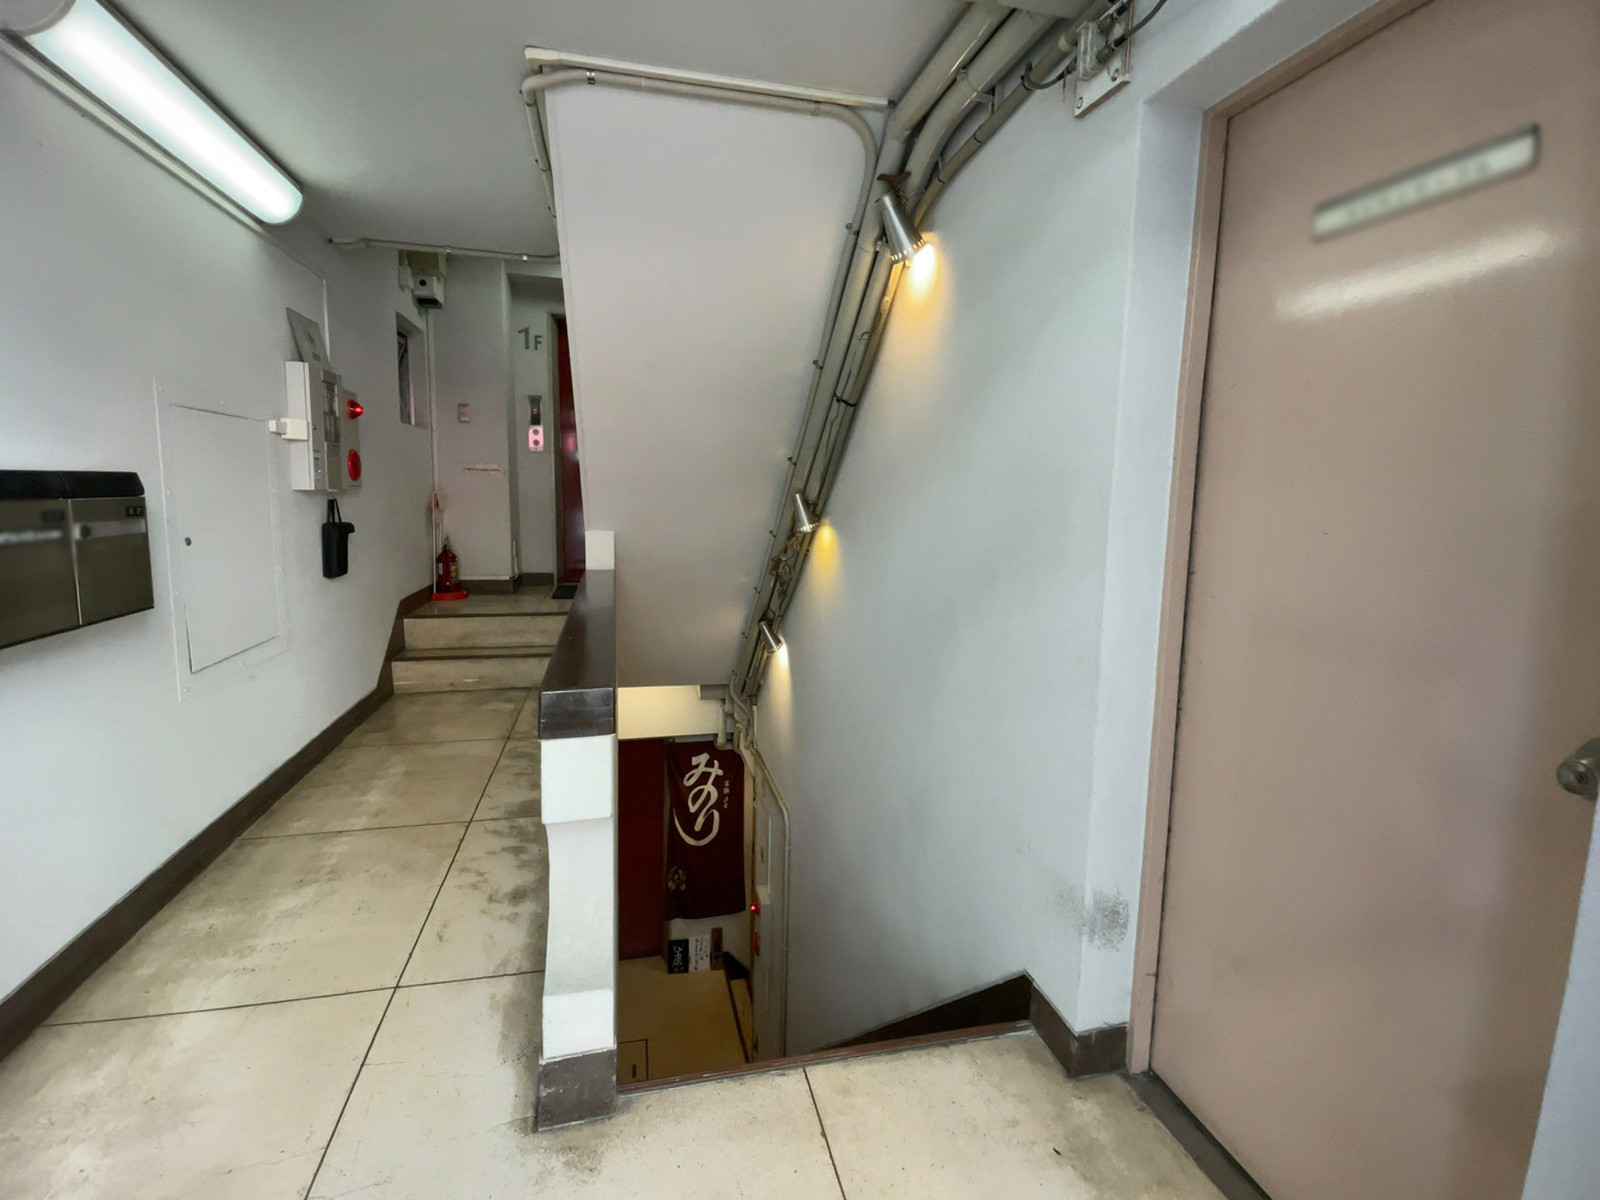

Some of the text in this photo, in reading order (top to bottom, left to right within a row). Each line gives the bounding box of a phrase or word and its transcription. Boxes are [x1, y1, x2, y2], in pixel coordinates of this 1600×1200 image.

[517, 326, 543, 351] 1F
[673, 752, 724, 846] みのり
